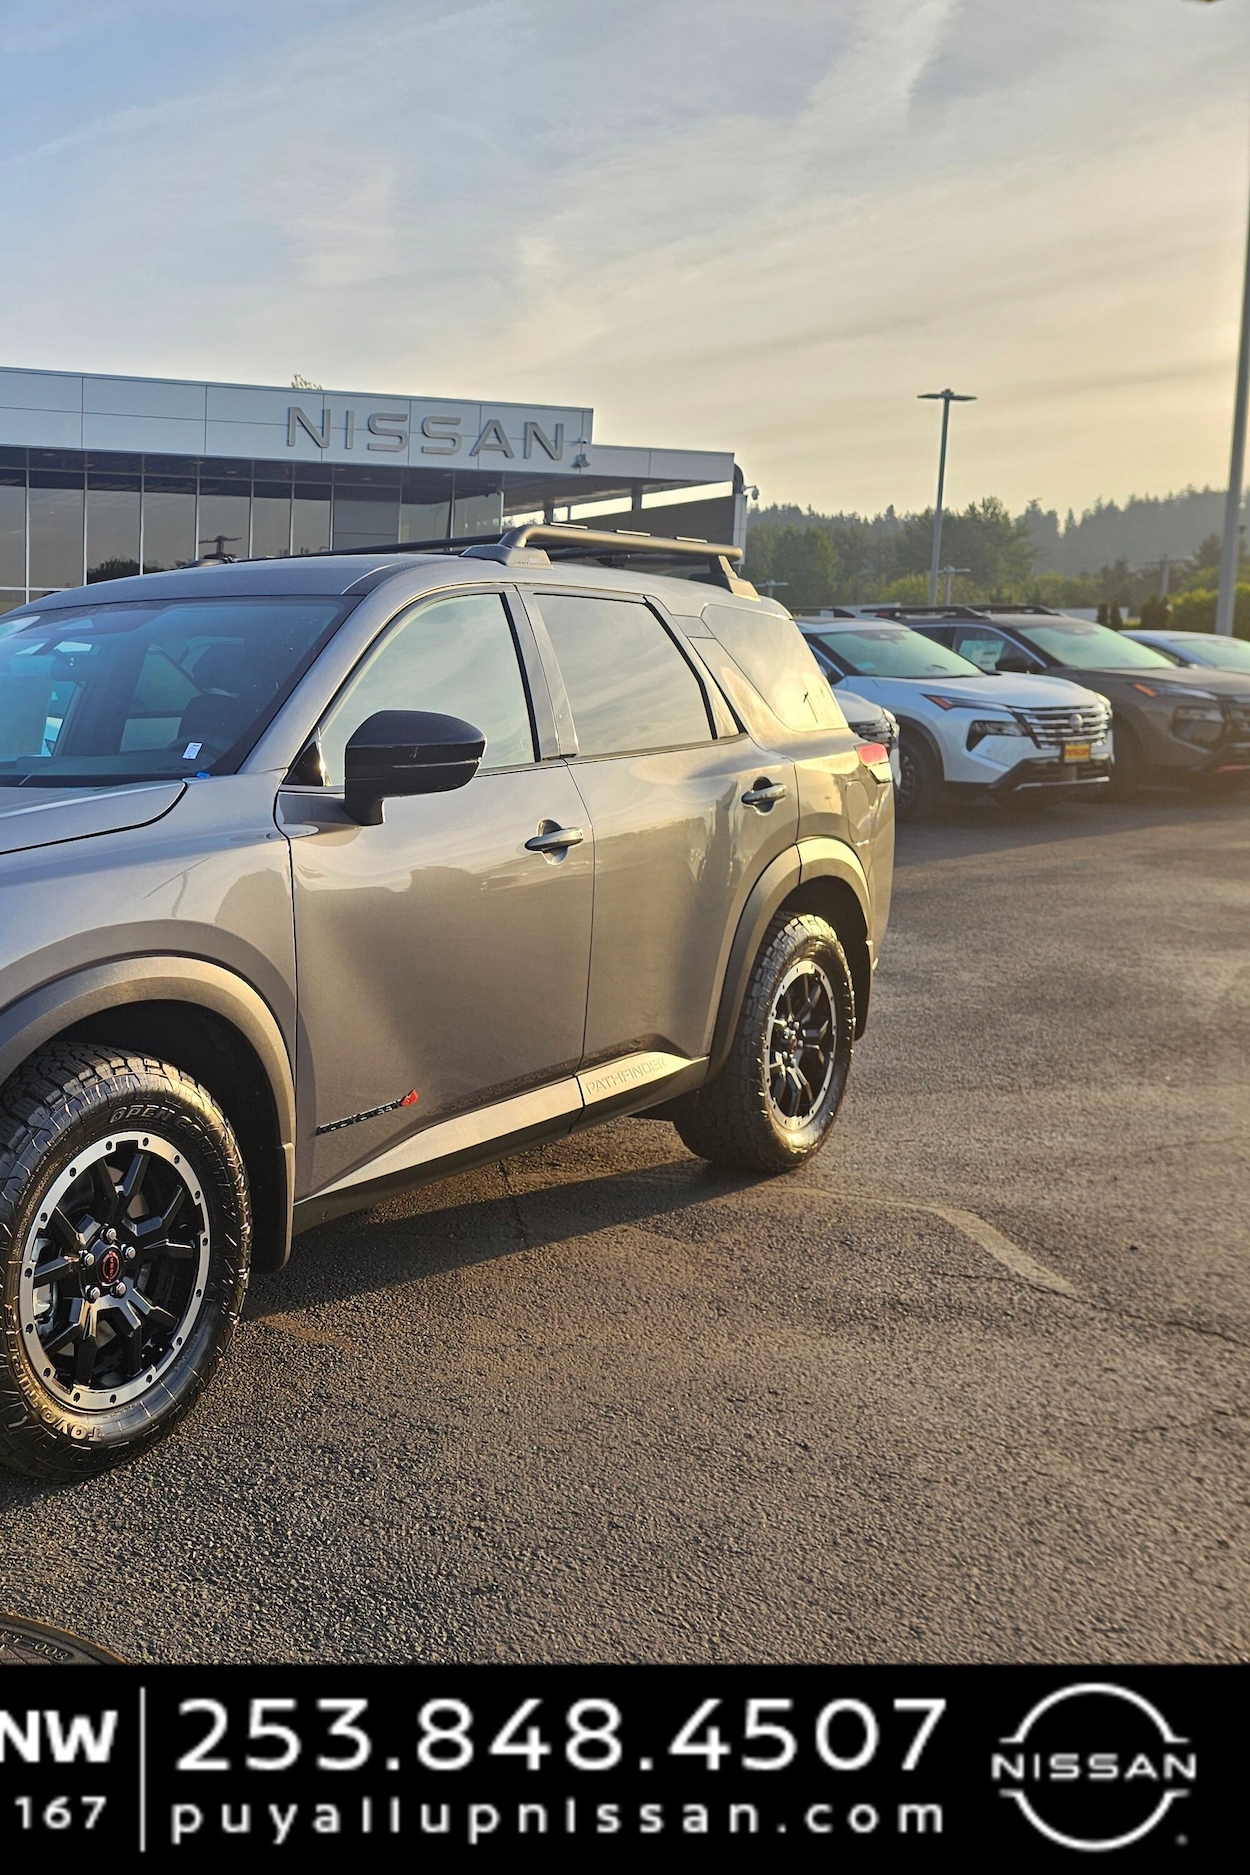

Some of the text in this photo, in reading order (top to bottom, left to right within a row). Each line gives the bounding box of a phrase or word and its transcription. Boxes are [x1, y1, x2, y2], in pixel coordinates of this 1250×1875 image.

[287, 405, 565, 462] NISSAN
[584, 1057, 668, 1096] PATHFINDER
[109, 1104, 176, 1124] OPEN
[40, 1404, 105, 1442] TOYO
